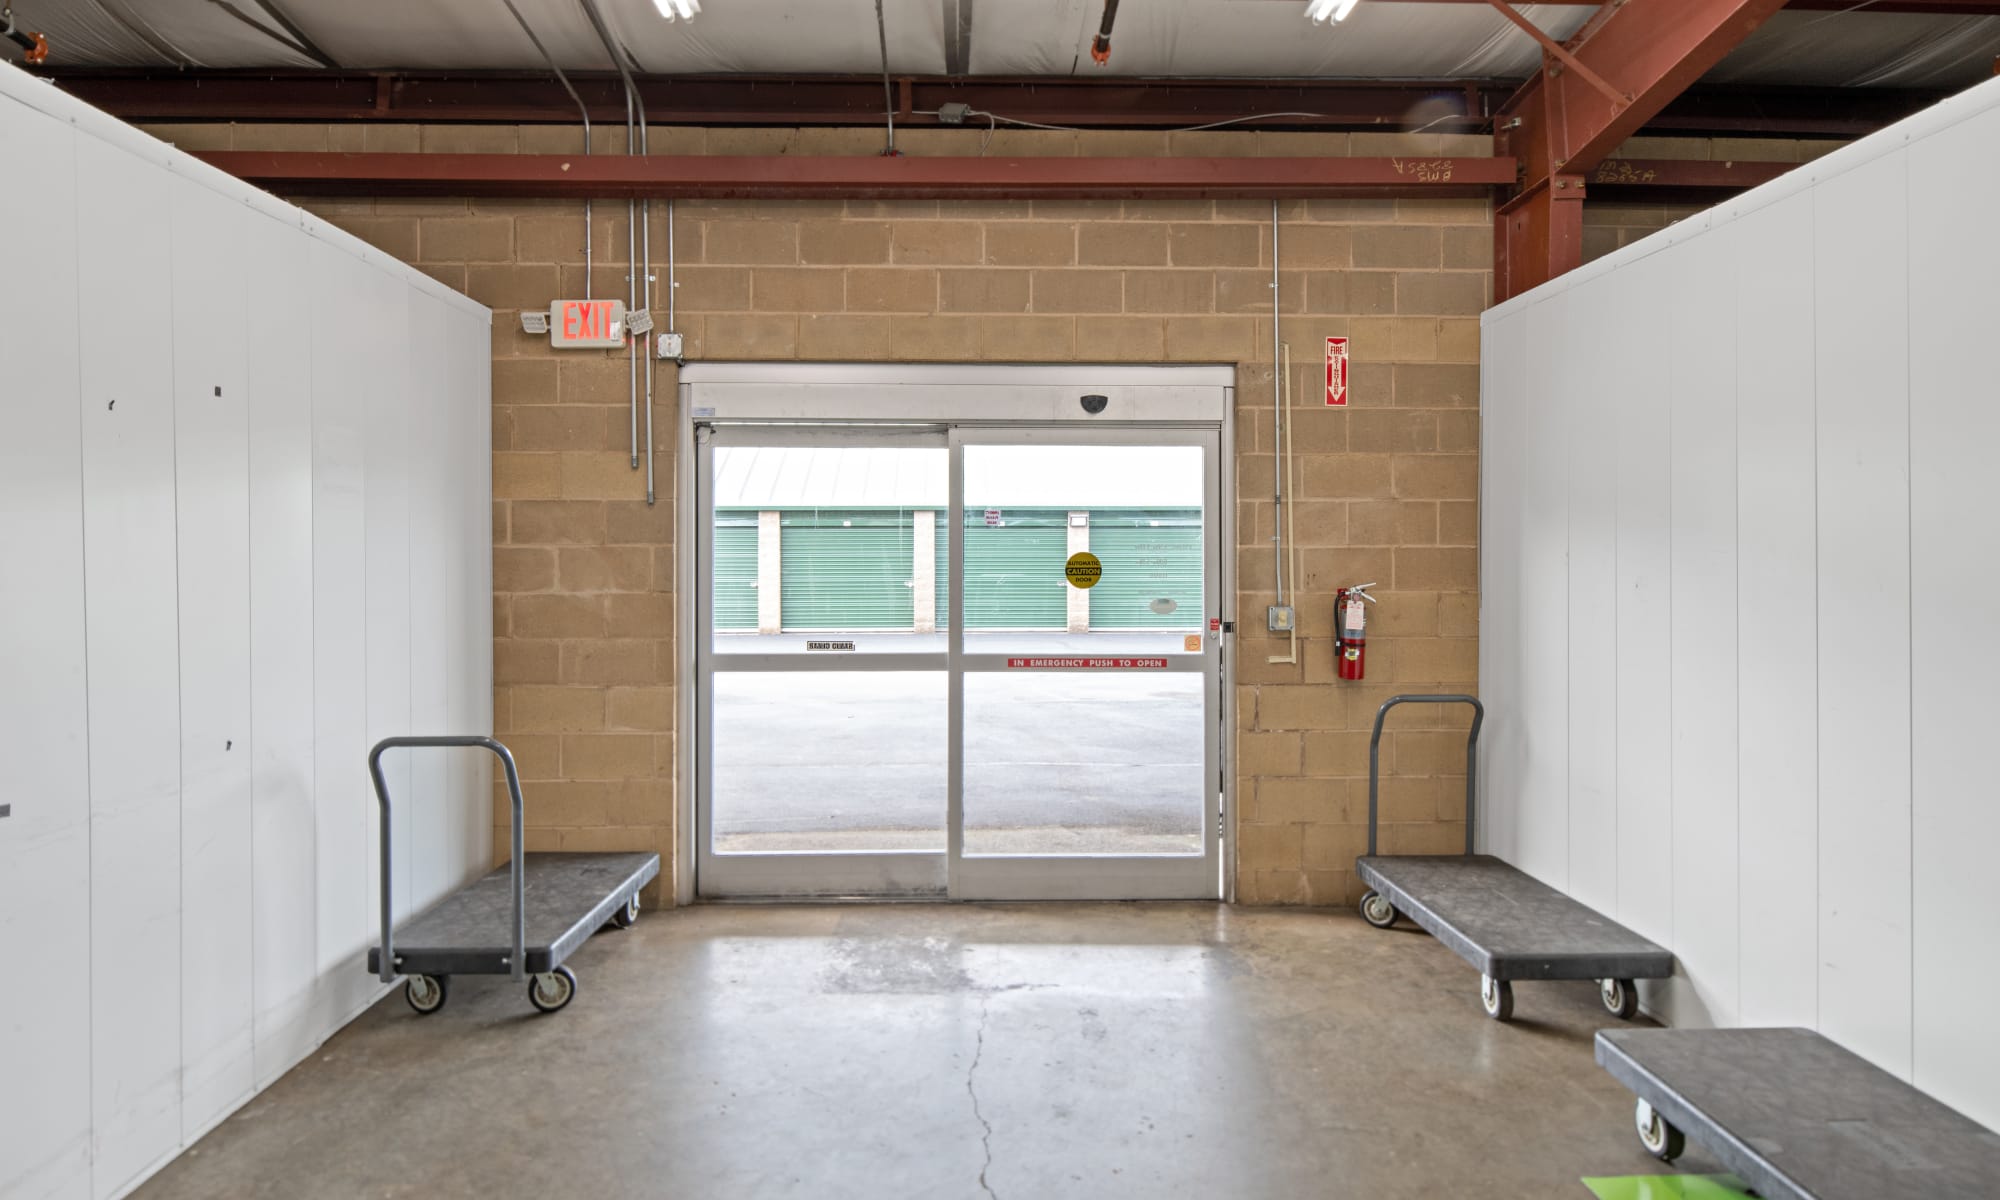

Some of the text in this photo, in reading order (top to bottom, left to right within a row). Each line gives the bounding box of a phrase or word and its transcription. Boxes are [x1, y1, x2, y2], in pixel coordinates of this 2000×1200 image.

[563, 302, 614, 340] EXIT
[1330, 345, 1343, 354] FIRE
[1013, 659, 1162, 667] IN EMERGENCY PUSH TO OPEN
